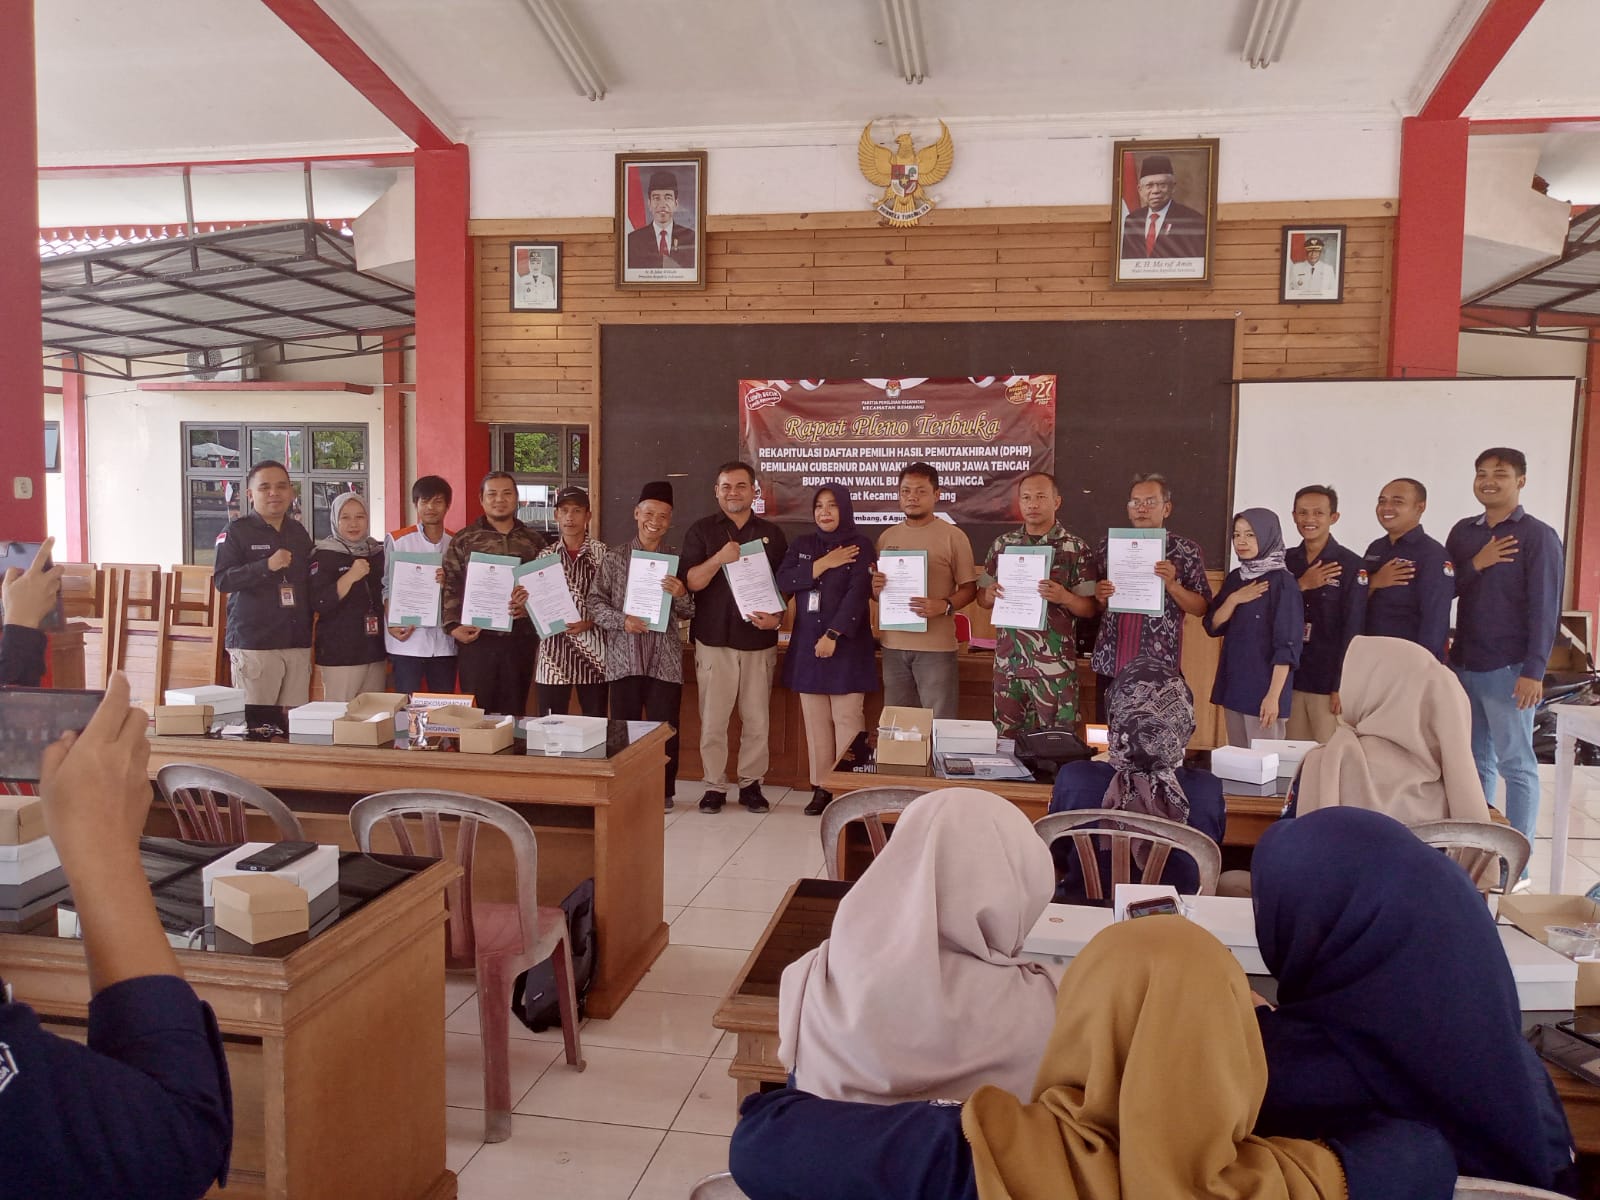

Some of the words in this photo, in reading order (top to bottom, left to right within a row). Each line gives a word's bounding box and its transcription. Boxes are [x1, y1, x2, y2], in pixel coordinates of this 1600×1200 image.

[1036, 381, 1054, 398] 27
[785, 416, 847, 443] Rapat
[852, 411, 909, 438] Pleno
[916, 410, 1001, 441] Terbuka
[758, 447, 822, 458] REKAPITULASI
[823, 447, 858, 458] DAFTAR
[860, 447, 895, 458] PEMILIH
[897, 447, 924, 457] HASIL
[925, 446, 998, 457] PEMUTAKHIRAN
[1000, 445, 1031, 458] (DPHP)
[760, 462, 808, 472] PEMILIHAN
[809, 462, 857, 472] GUBERNUR
[859, 462, 878, 472] DAN
[962, 461, 989, 471] JAWA
[991, 461, 1029, 471] TENGAH
[803, 477, 834, 487] BUPATI
[835, 477, 853, 487] DAN
[854, 477, 884, 487] WAKIL
